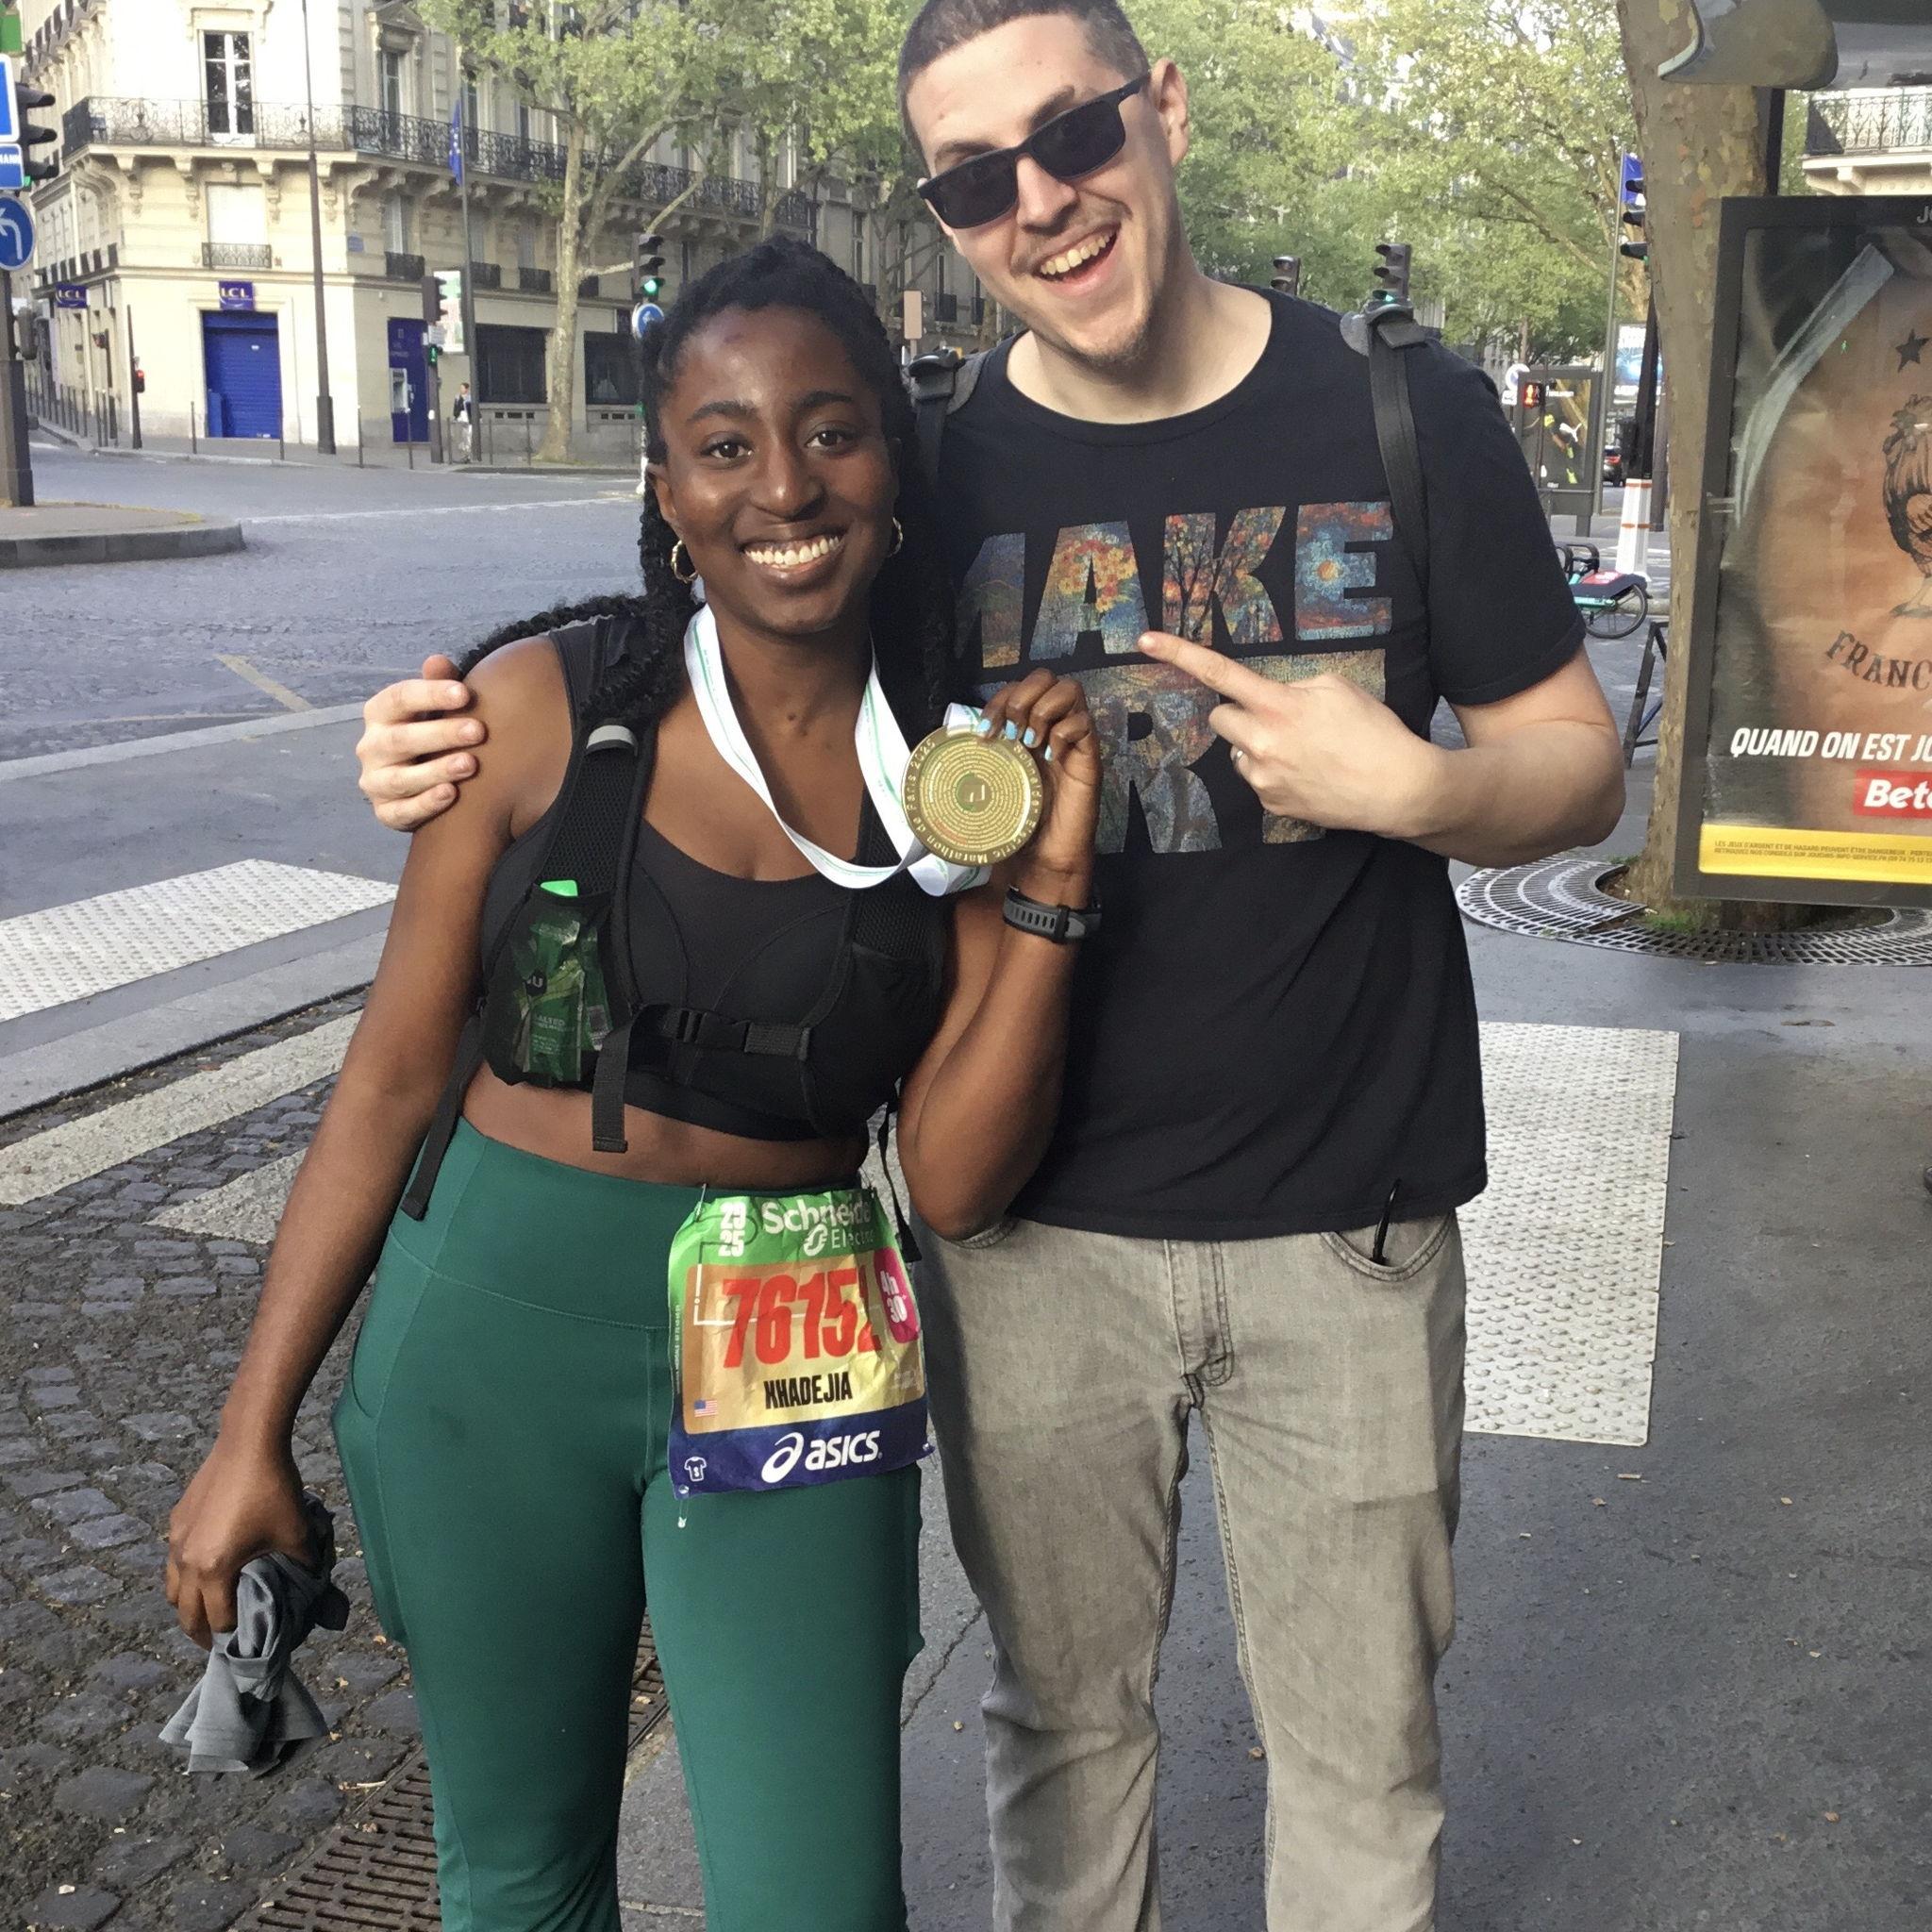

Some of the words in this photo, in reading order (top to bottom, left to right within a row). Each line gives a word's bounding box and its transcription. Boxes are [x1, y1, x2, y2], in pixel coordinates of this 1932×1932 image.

[222, 288, 249, 298] LCL
[910, 739, 937, 771] 2025
[1730, 727, 1820, 758] QUAND
[1821, 732, 1861, 759] ON
[1861, 733, 1911, 761] EST
[907, 774, 917, 811] Paris
[912, 817, 926, 832] de
[926, 834, 989, 864] Marathon
[718, 1229, 746, 1257] 25
[763, 1371, 853, 1410] KHADEJIA
